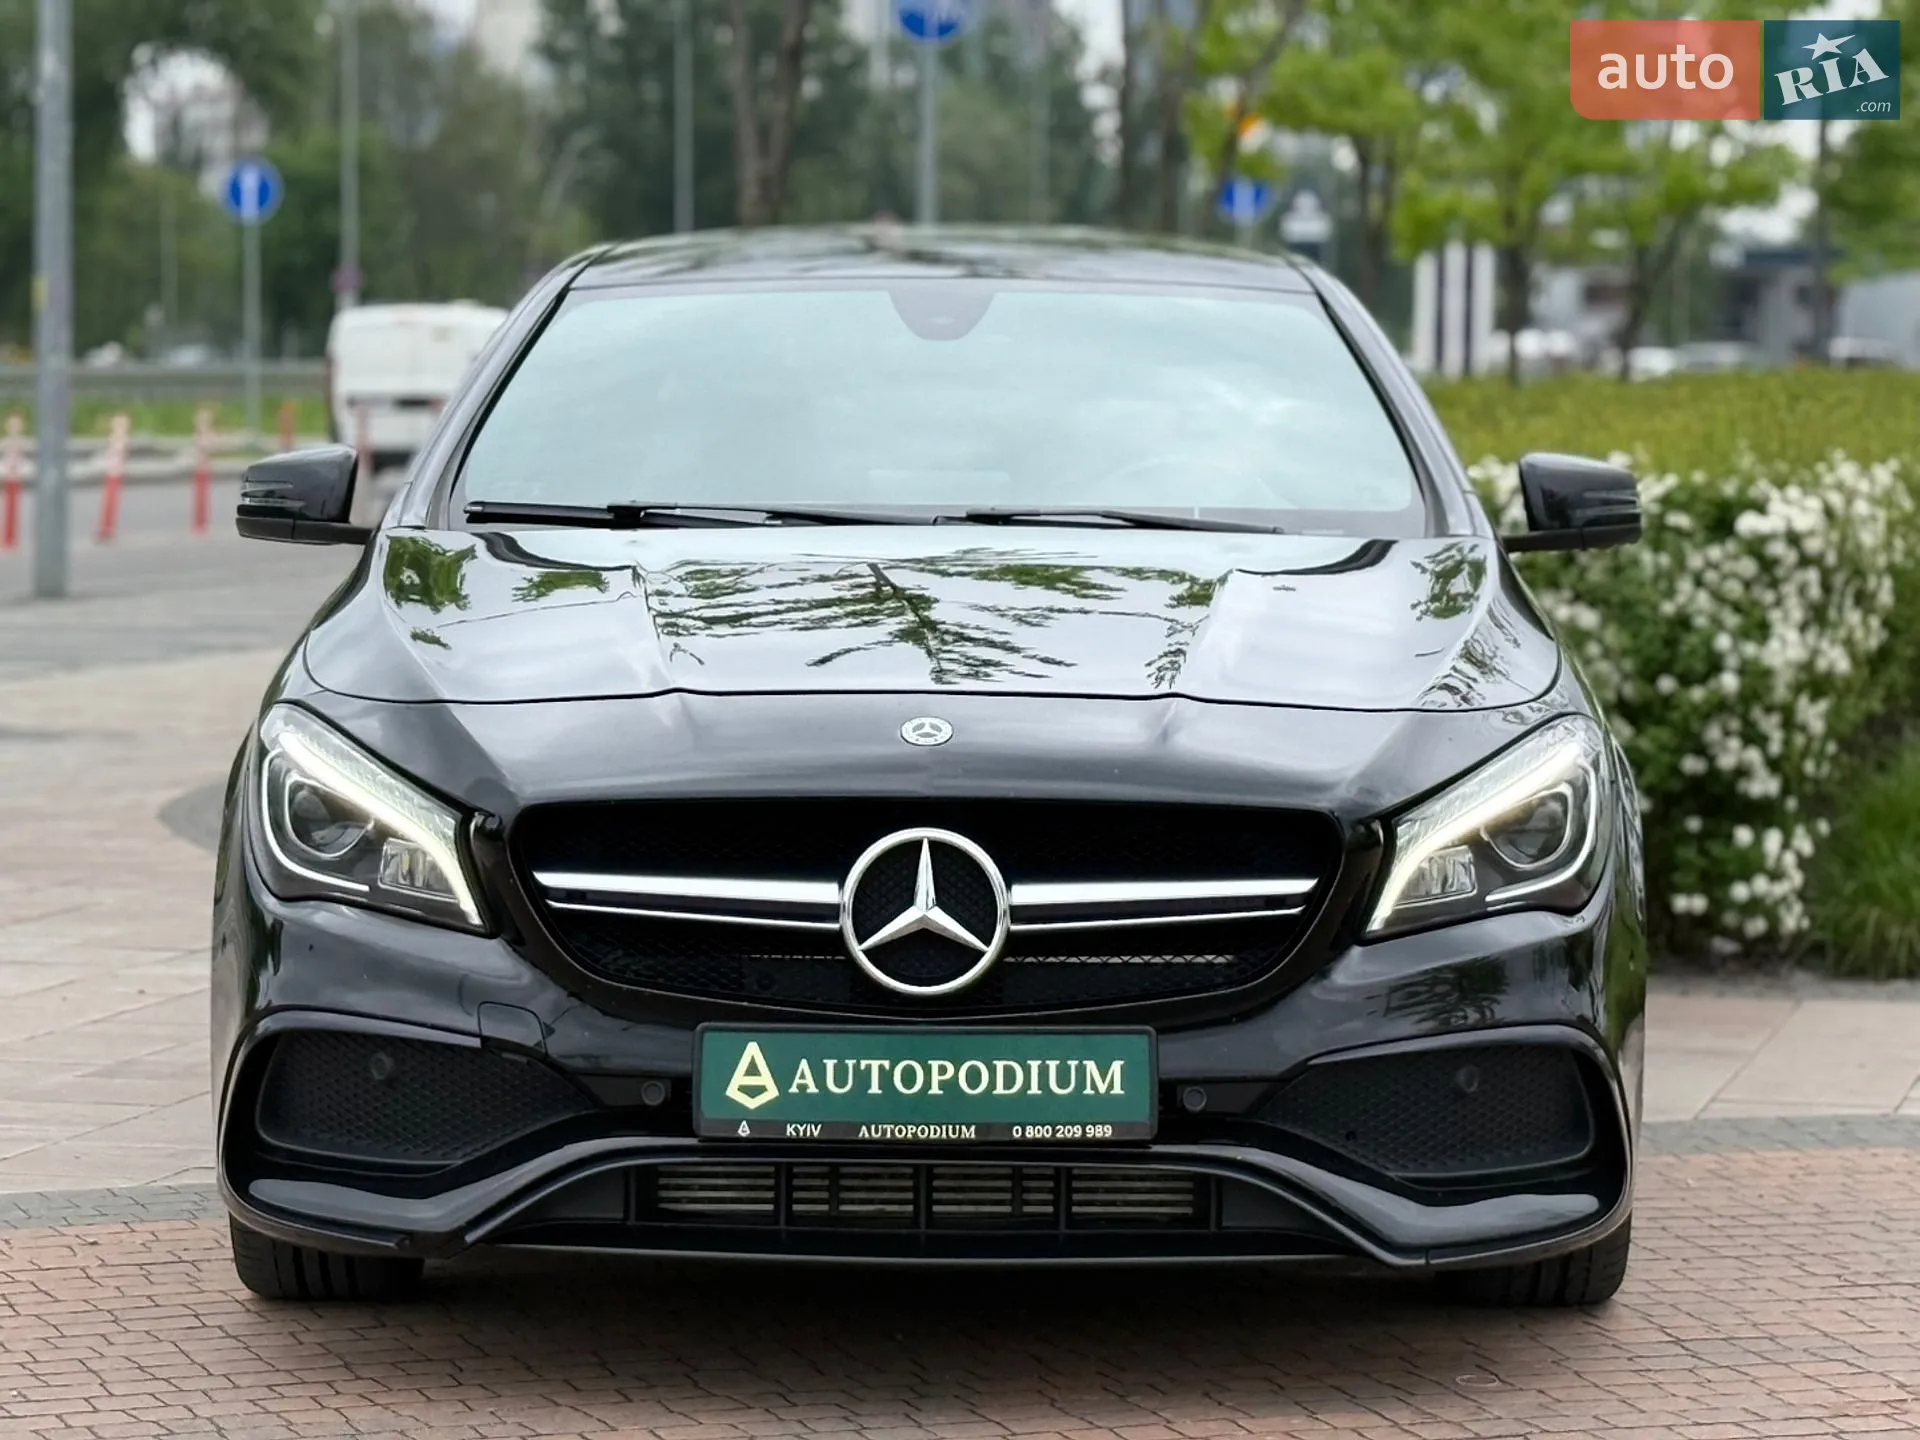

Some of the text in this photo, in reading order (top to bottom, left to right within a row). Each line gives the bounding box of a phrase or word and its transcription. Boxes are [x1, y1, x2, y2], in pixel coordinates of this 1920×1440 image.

[788, 1058, 1125, 1095] AUTOPODIUM
[786, 1124, 1112, 1139] KYIV AUTOPODIUM 0 800 209 989
